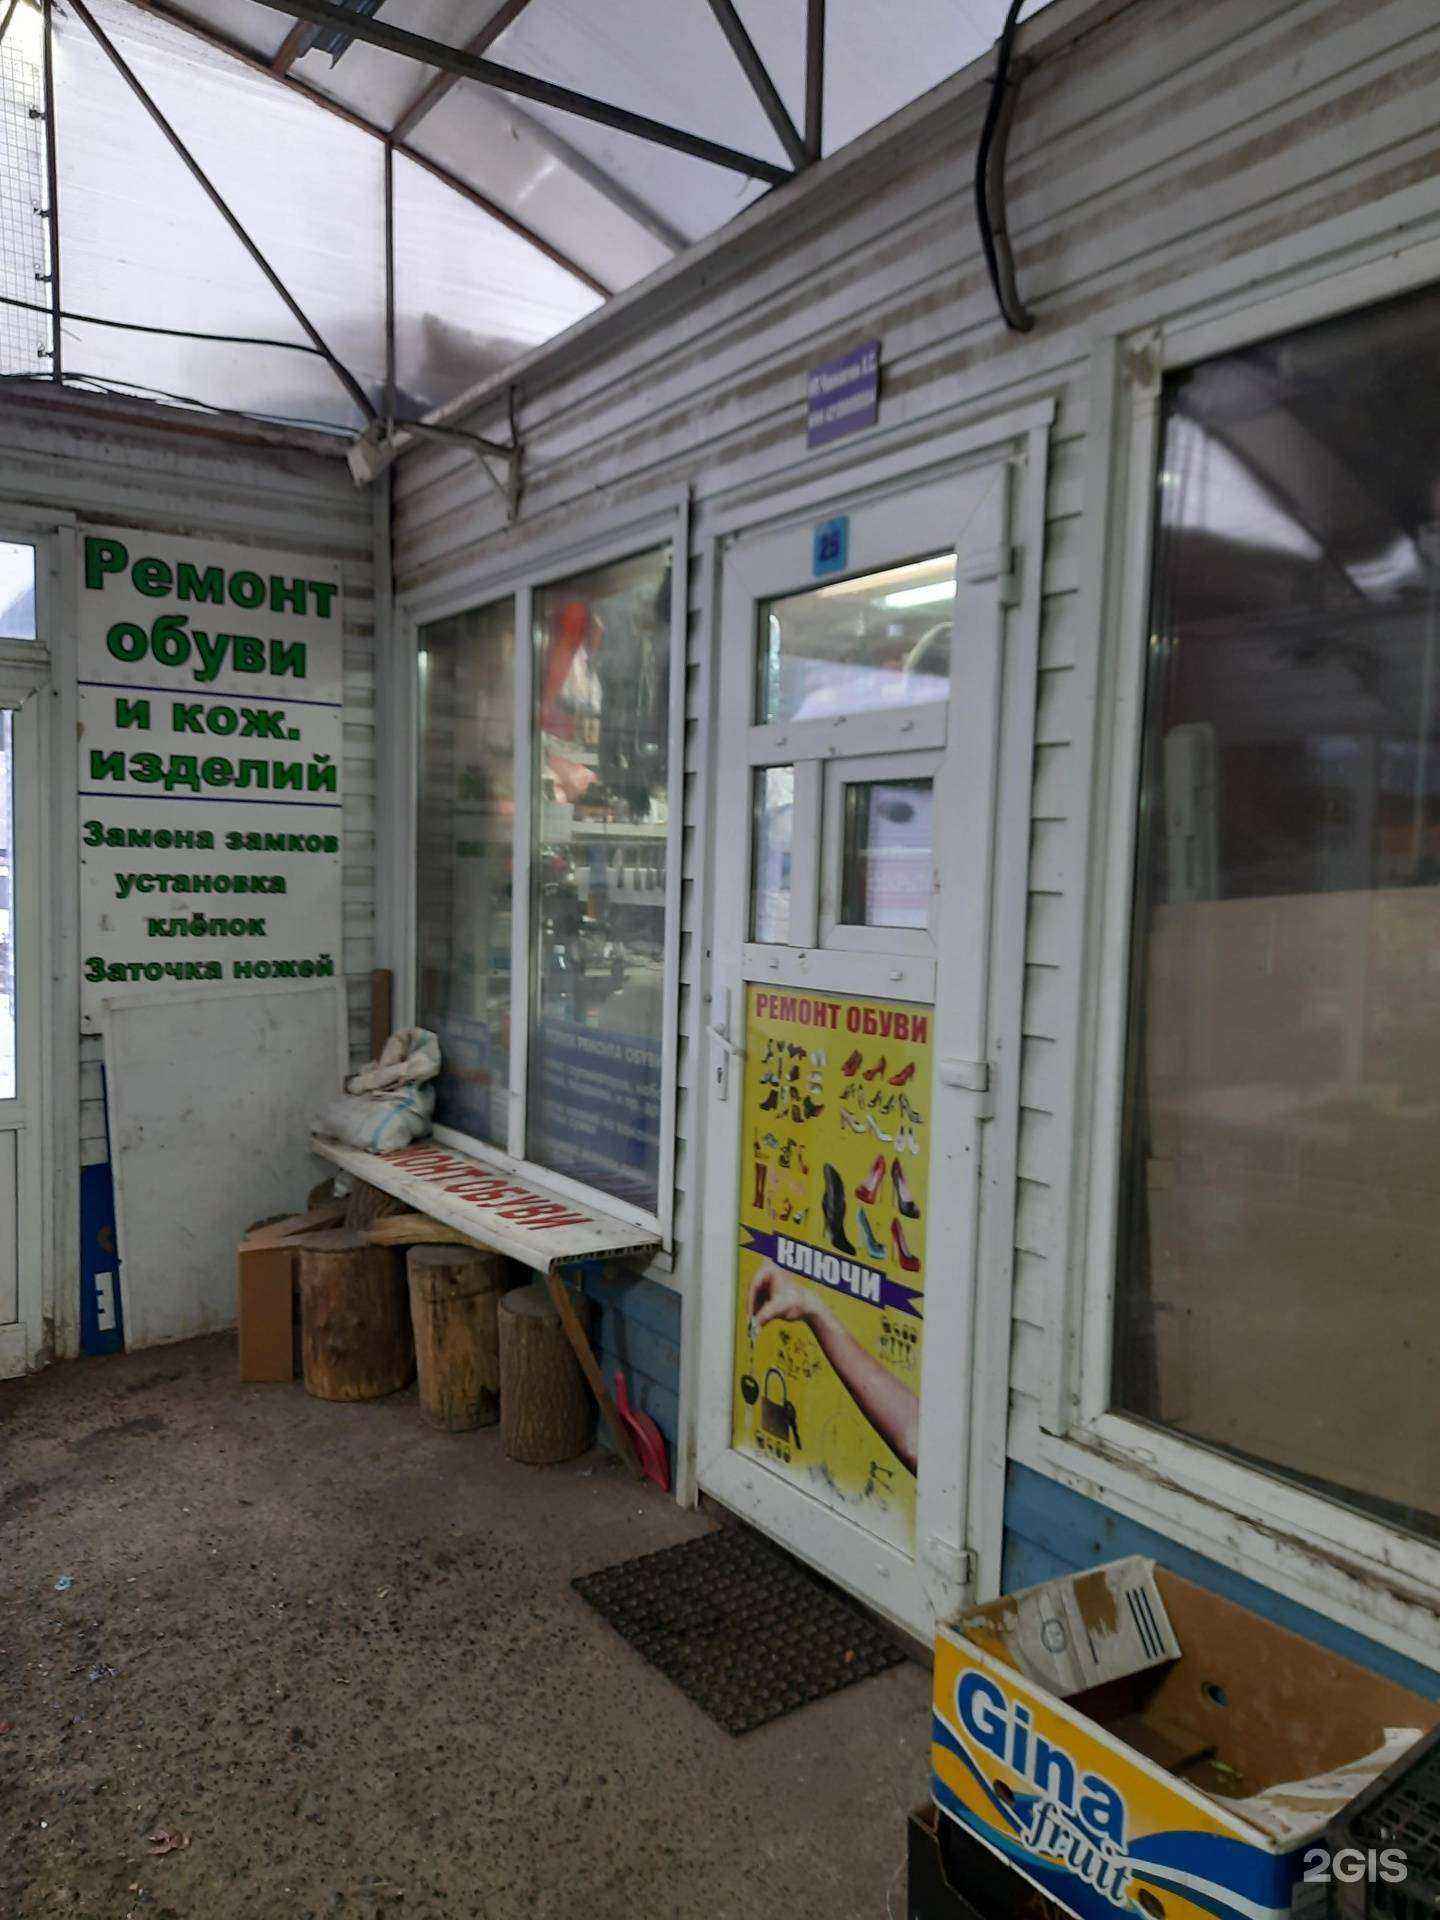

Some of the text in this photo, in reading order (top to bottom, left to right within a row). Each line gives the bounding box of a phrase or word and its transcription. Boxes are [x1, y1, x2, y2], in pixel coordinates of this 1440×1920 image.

[85, 537, 338, 618] Ремонт
[106, 614, 307, 683] обуви
[116, 698, 302, 740] и кож.
[90, 752, 337, 792] изделий
[83, 820, 339, 854] Замена замков
[114, 871, 287, 899] установка
[147, 912, 267, 937] клёпок
[84, 954, 335, 983] Заточка ножей
[756, 993, 927, 1043] РЕМОНТ ОБУВИ
[373, 1146, 494, 1182] МОНТ
[444, 1180, 594, 1231] ОБУВИ
[776, 1236, 881, 1302] КЛЮЧИ
[957, 1671, 1127, 1852] Gina
[1024, 1802, 1132, 1904] fruit
